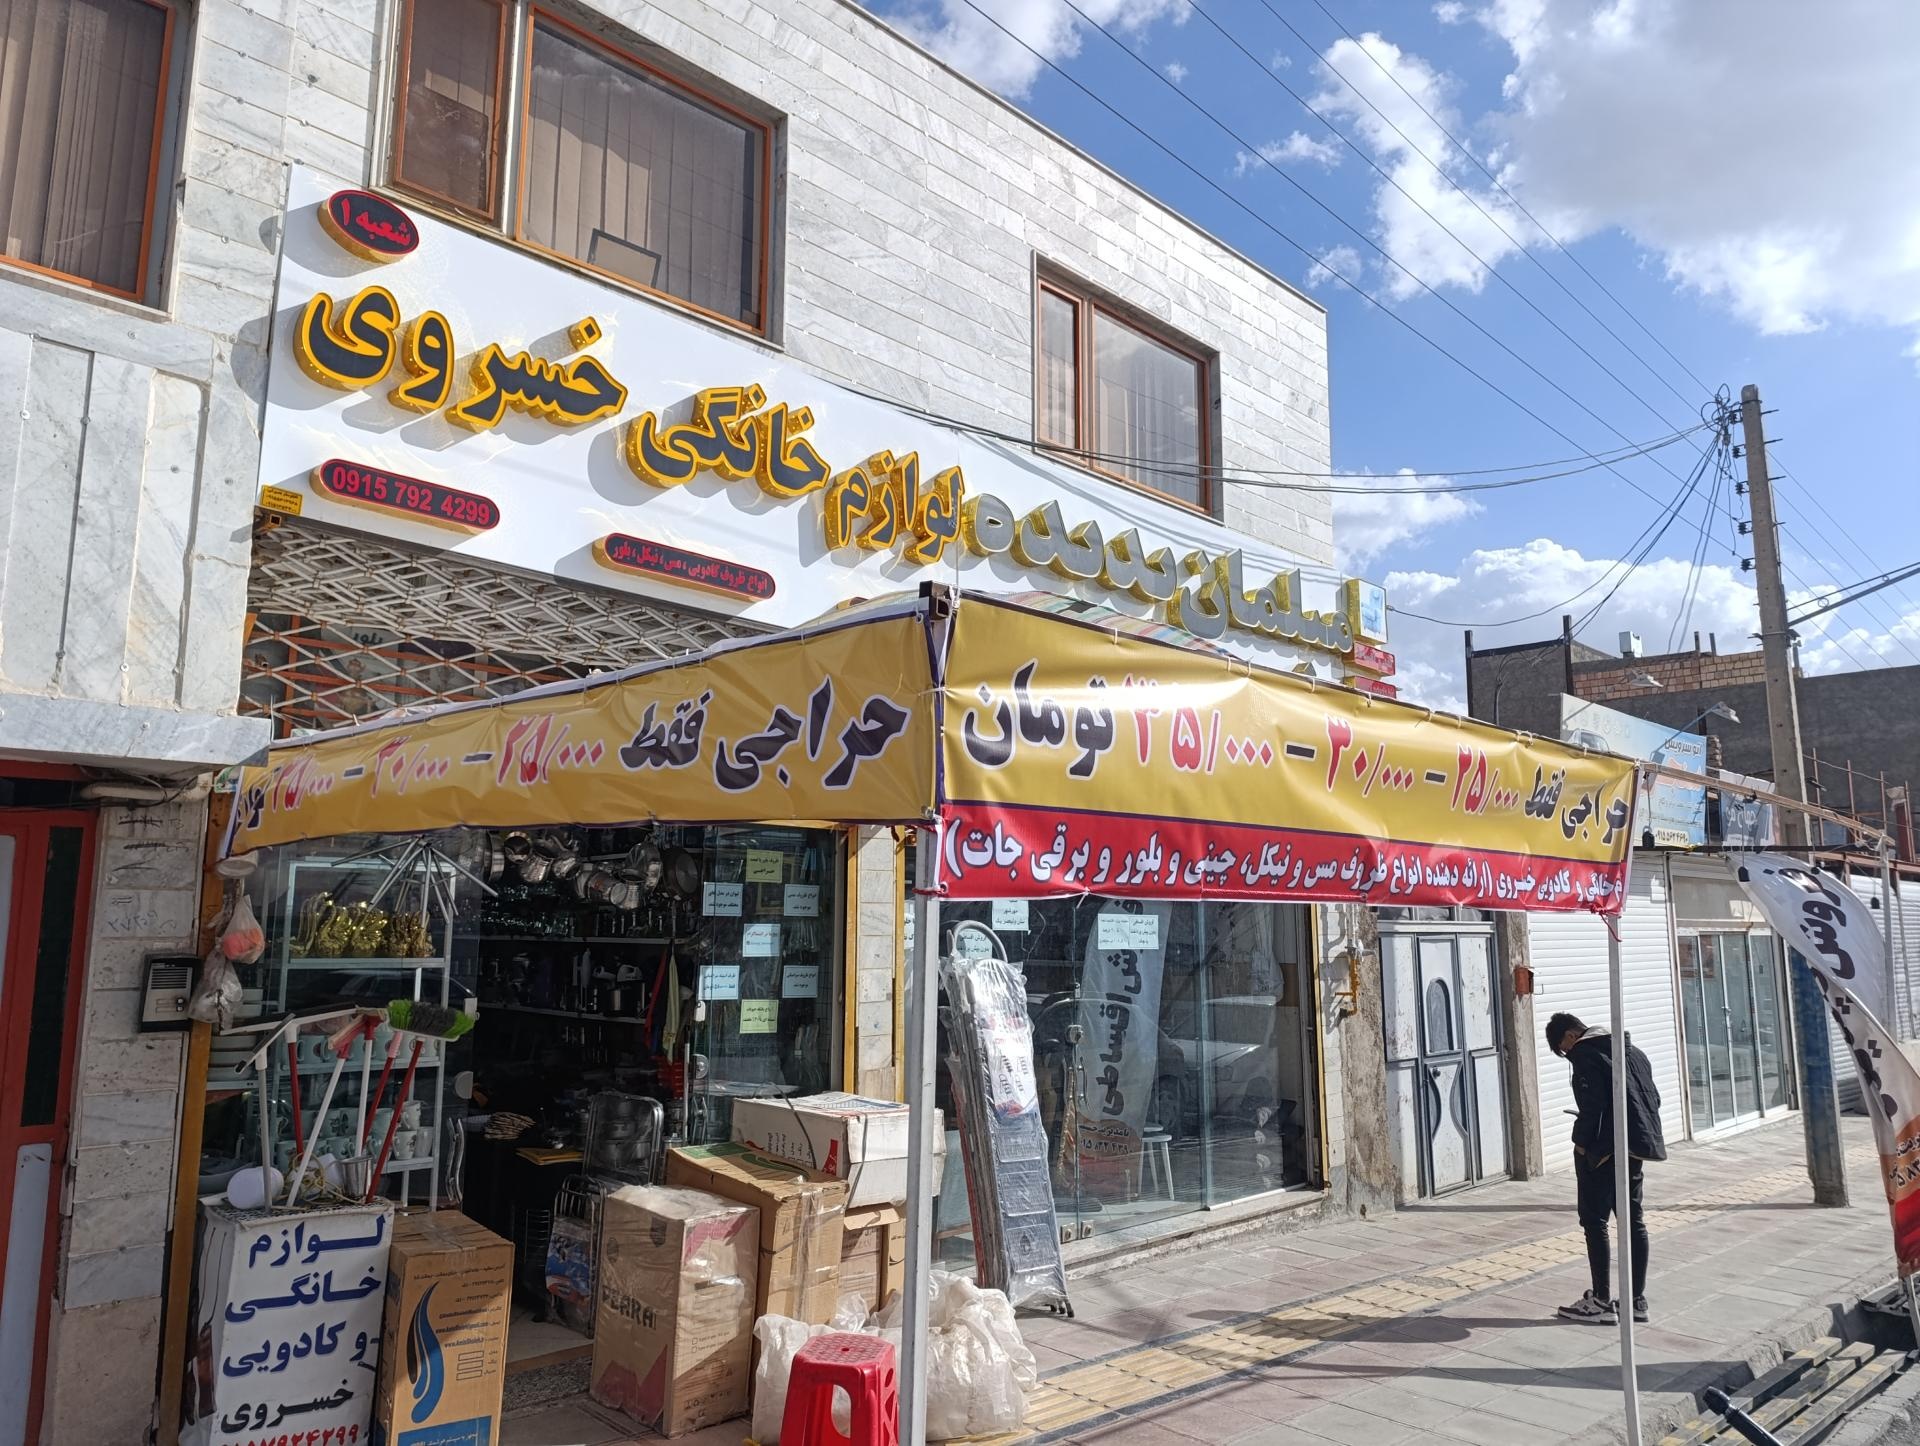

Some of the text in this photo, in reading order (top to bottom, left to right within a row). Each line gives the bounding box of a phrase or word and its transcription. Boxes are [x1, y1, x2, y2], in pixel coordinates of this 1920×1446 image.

[355, 211, 411, 246] شعبه
[301, 284, 629, 428] خسروی
[631, 383, 831, 498] خانگی
[332, 465, 388, 500] 0915
[394, 481, 434, 512] 792
[440, 493, 491, 526] 4299
[838, 450, 964, 563] لوازم
[747, 575, 769, 595] انواع
[619, 690, 714, 771] فقط
[714, 673, 911, 791] حراجی
[964, 660, 1114, 778] تومان
[1324, 715, 1414, 796] ۳۰/۰۰۰
[1452, 744, 1520, 815] ۲۵/۰۰۰
[1525, 764, 1566, 819] فقط
[1561, 780, 1629, 845] حراجی
[1030, 823, 1091, 882] برقی
[1092, 847, 1113, 883] و
[1114, 832, 1163, 885] بلور
[1165, 850, 1181, 885] و
[1184, 842, 1237, 885] چینی
[1286, 859, 1302, 889] و
[1304, 858, 1338, 889] مس
[1340, 847, 1389, 892] ظروف
[1389, 852, 1423, 894] انواع
[1425, 862, 1459, 888] دهنده
[1496, 866, 1536, 899] خسروی
[249, 1214, 386, 1268] لوازم
[224, 1266, 382, 1323] خانگی
[222, 1320, 368, 1377] و کادویی
[220, 1378, 355, 1434] خسروی
